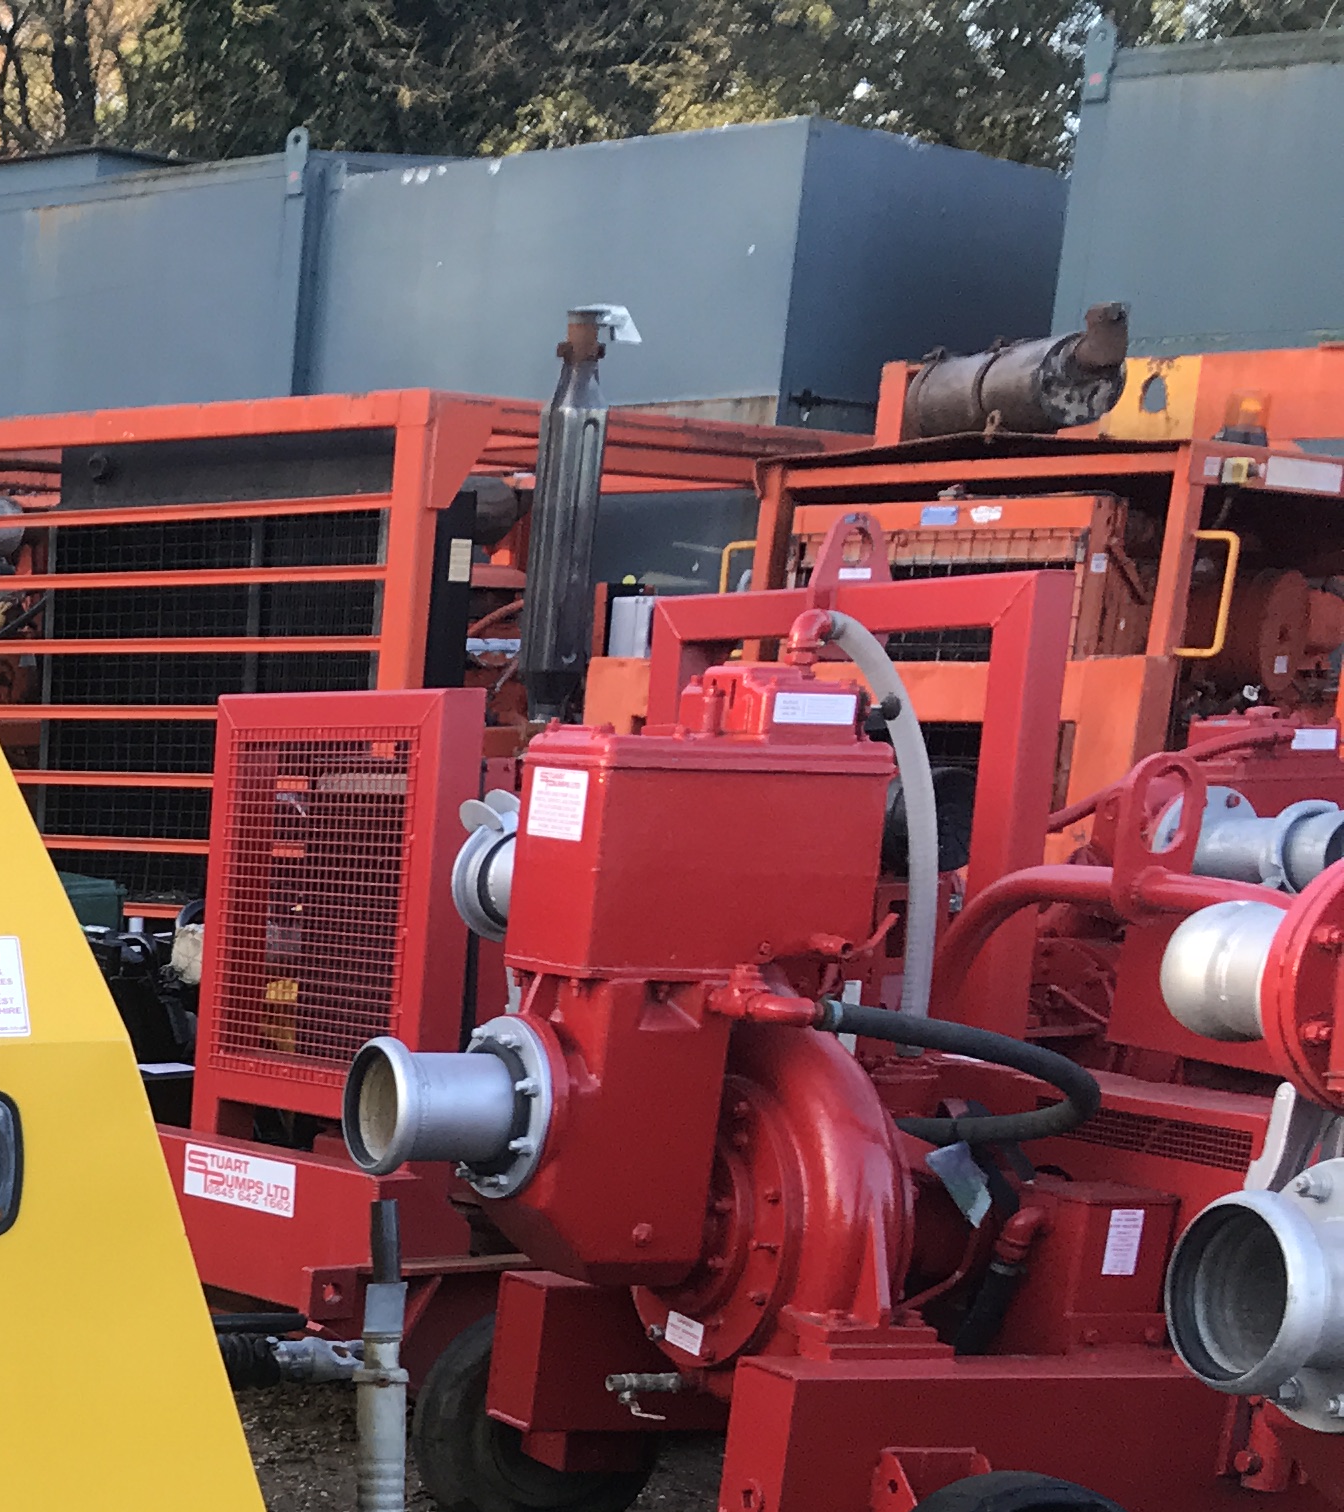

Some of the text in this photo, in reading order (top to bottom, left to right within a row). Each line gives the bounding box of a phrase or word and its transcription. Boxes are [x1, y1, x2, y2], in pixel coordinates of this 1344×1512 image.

[188, 1150, 250, 1174] STUART
[187, 1165, 290, 1201] PUMPS LTD
[237, 1191, 259, 1205] 642
